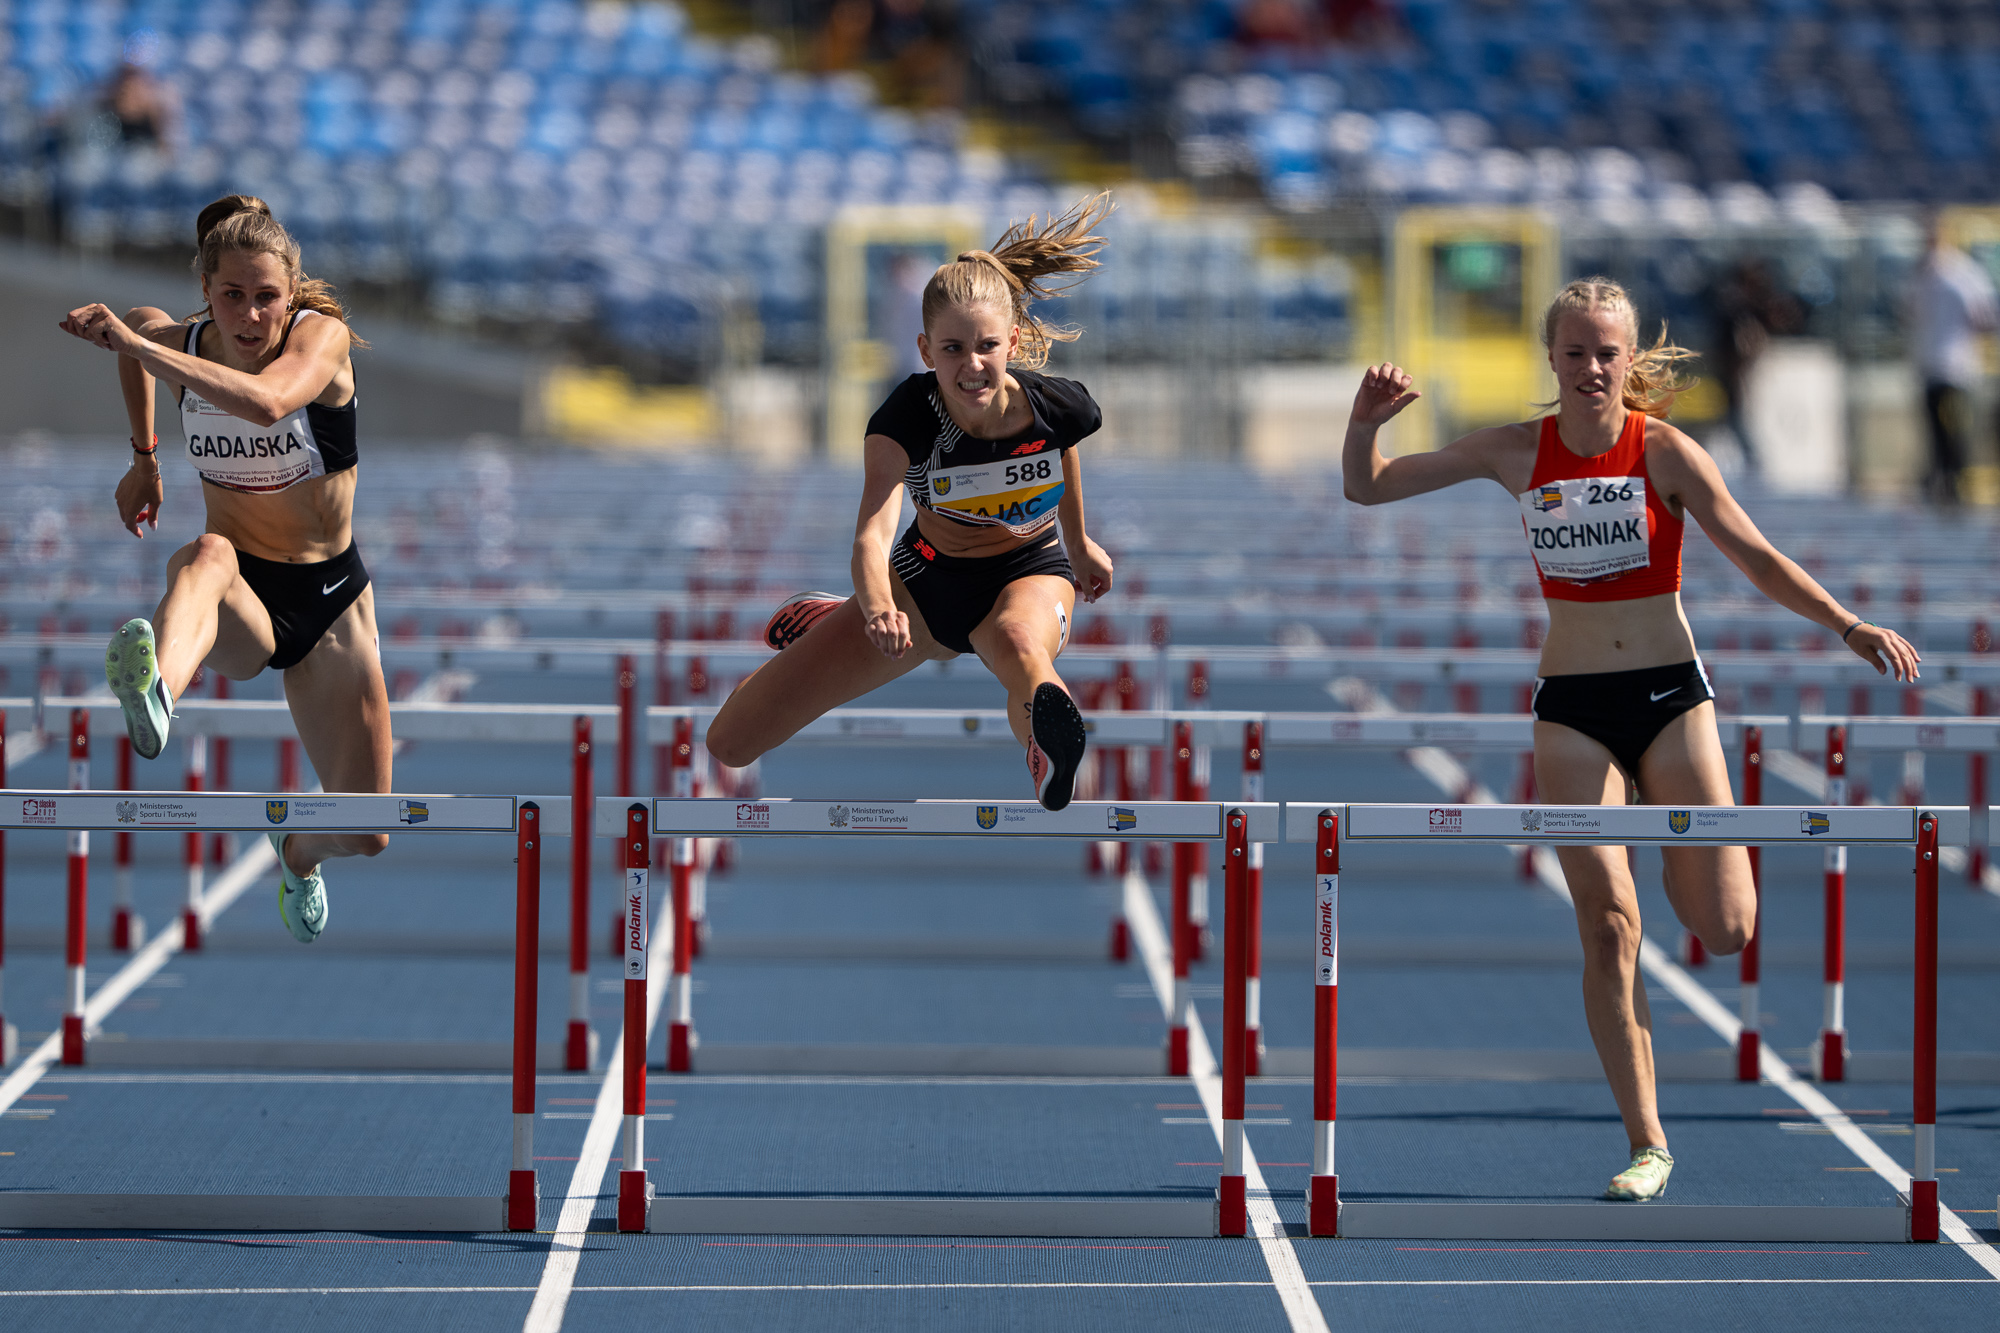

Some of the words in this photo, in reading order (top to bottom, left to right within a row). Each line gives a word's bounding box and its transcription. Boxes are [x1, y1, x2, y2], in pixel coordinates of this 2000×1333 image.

[189, 431, 303, 458] GADAJSKA
[270, 469, 295, 482] Polski
[1004, 459, 1051, 486] 588
[1587, 482, 1634, 505] 266
[956, 498, 1042, 521] AJĄC
[1530, 518, 1643, 550] ZOCHNIAK
[139, 802, 184, 810] Ministerstwo
[294, 801, 337, 809] Województwo
[139, 810, 162, 819] Sportu
[166, 810, 197, 819] Turystyki
[294, 808, 317, 817] Śląskie
[851, 807, 895, 815] Ministerstwo
[1004, 807, 1046, 815] Województwo
[1543, 811, 1587, 819] Ministerstwo
[1696, 811, 1739, 819] Województwo
[851, 815, 873, 824] Sportu
[878, 815, 909, 824] Turystyki
[1004, 814, 1026, 823] Śląskie
[1696, 819, 1719, 827] Śląskie
[1543, 819, 1566, 828] Sportu
[1570, 819, 1601, 828] Turystyki
[628, 894, 643, 952] polanik
[1319, 900, 1334, 958] polanik
